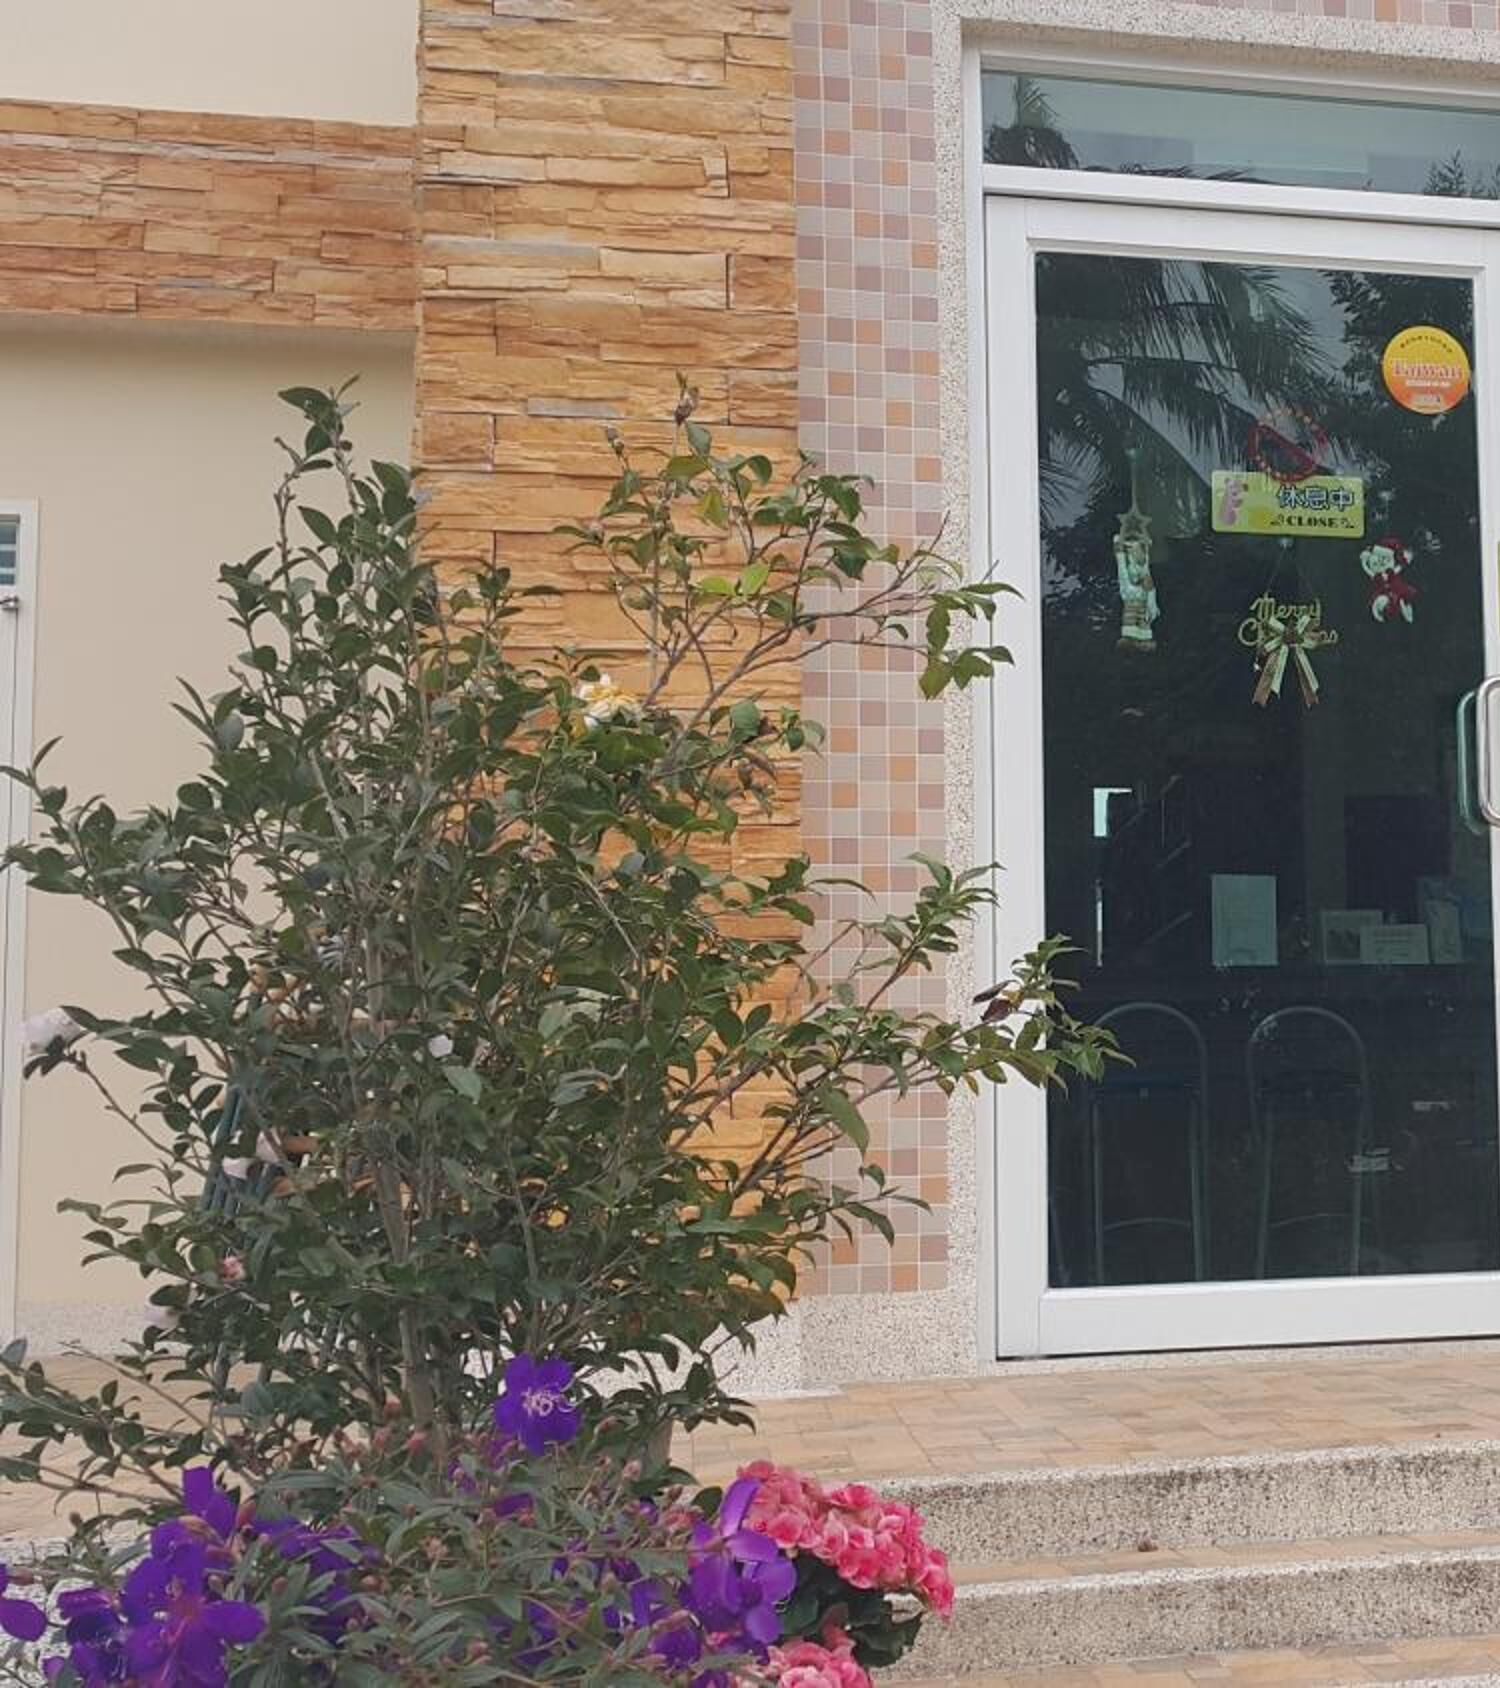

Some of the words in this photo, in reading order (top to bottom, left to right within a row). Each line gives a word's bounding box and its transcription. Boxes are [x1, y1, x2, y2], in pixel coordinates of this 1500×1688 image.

[1276, 484, 1355, 512] 休息中
[1286, 514, 1338, 528] CLOSE
